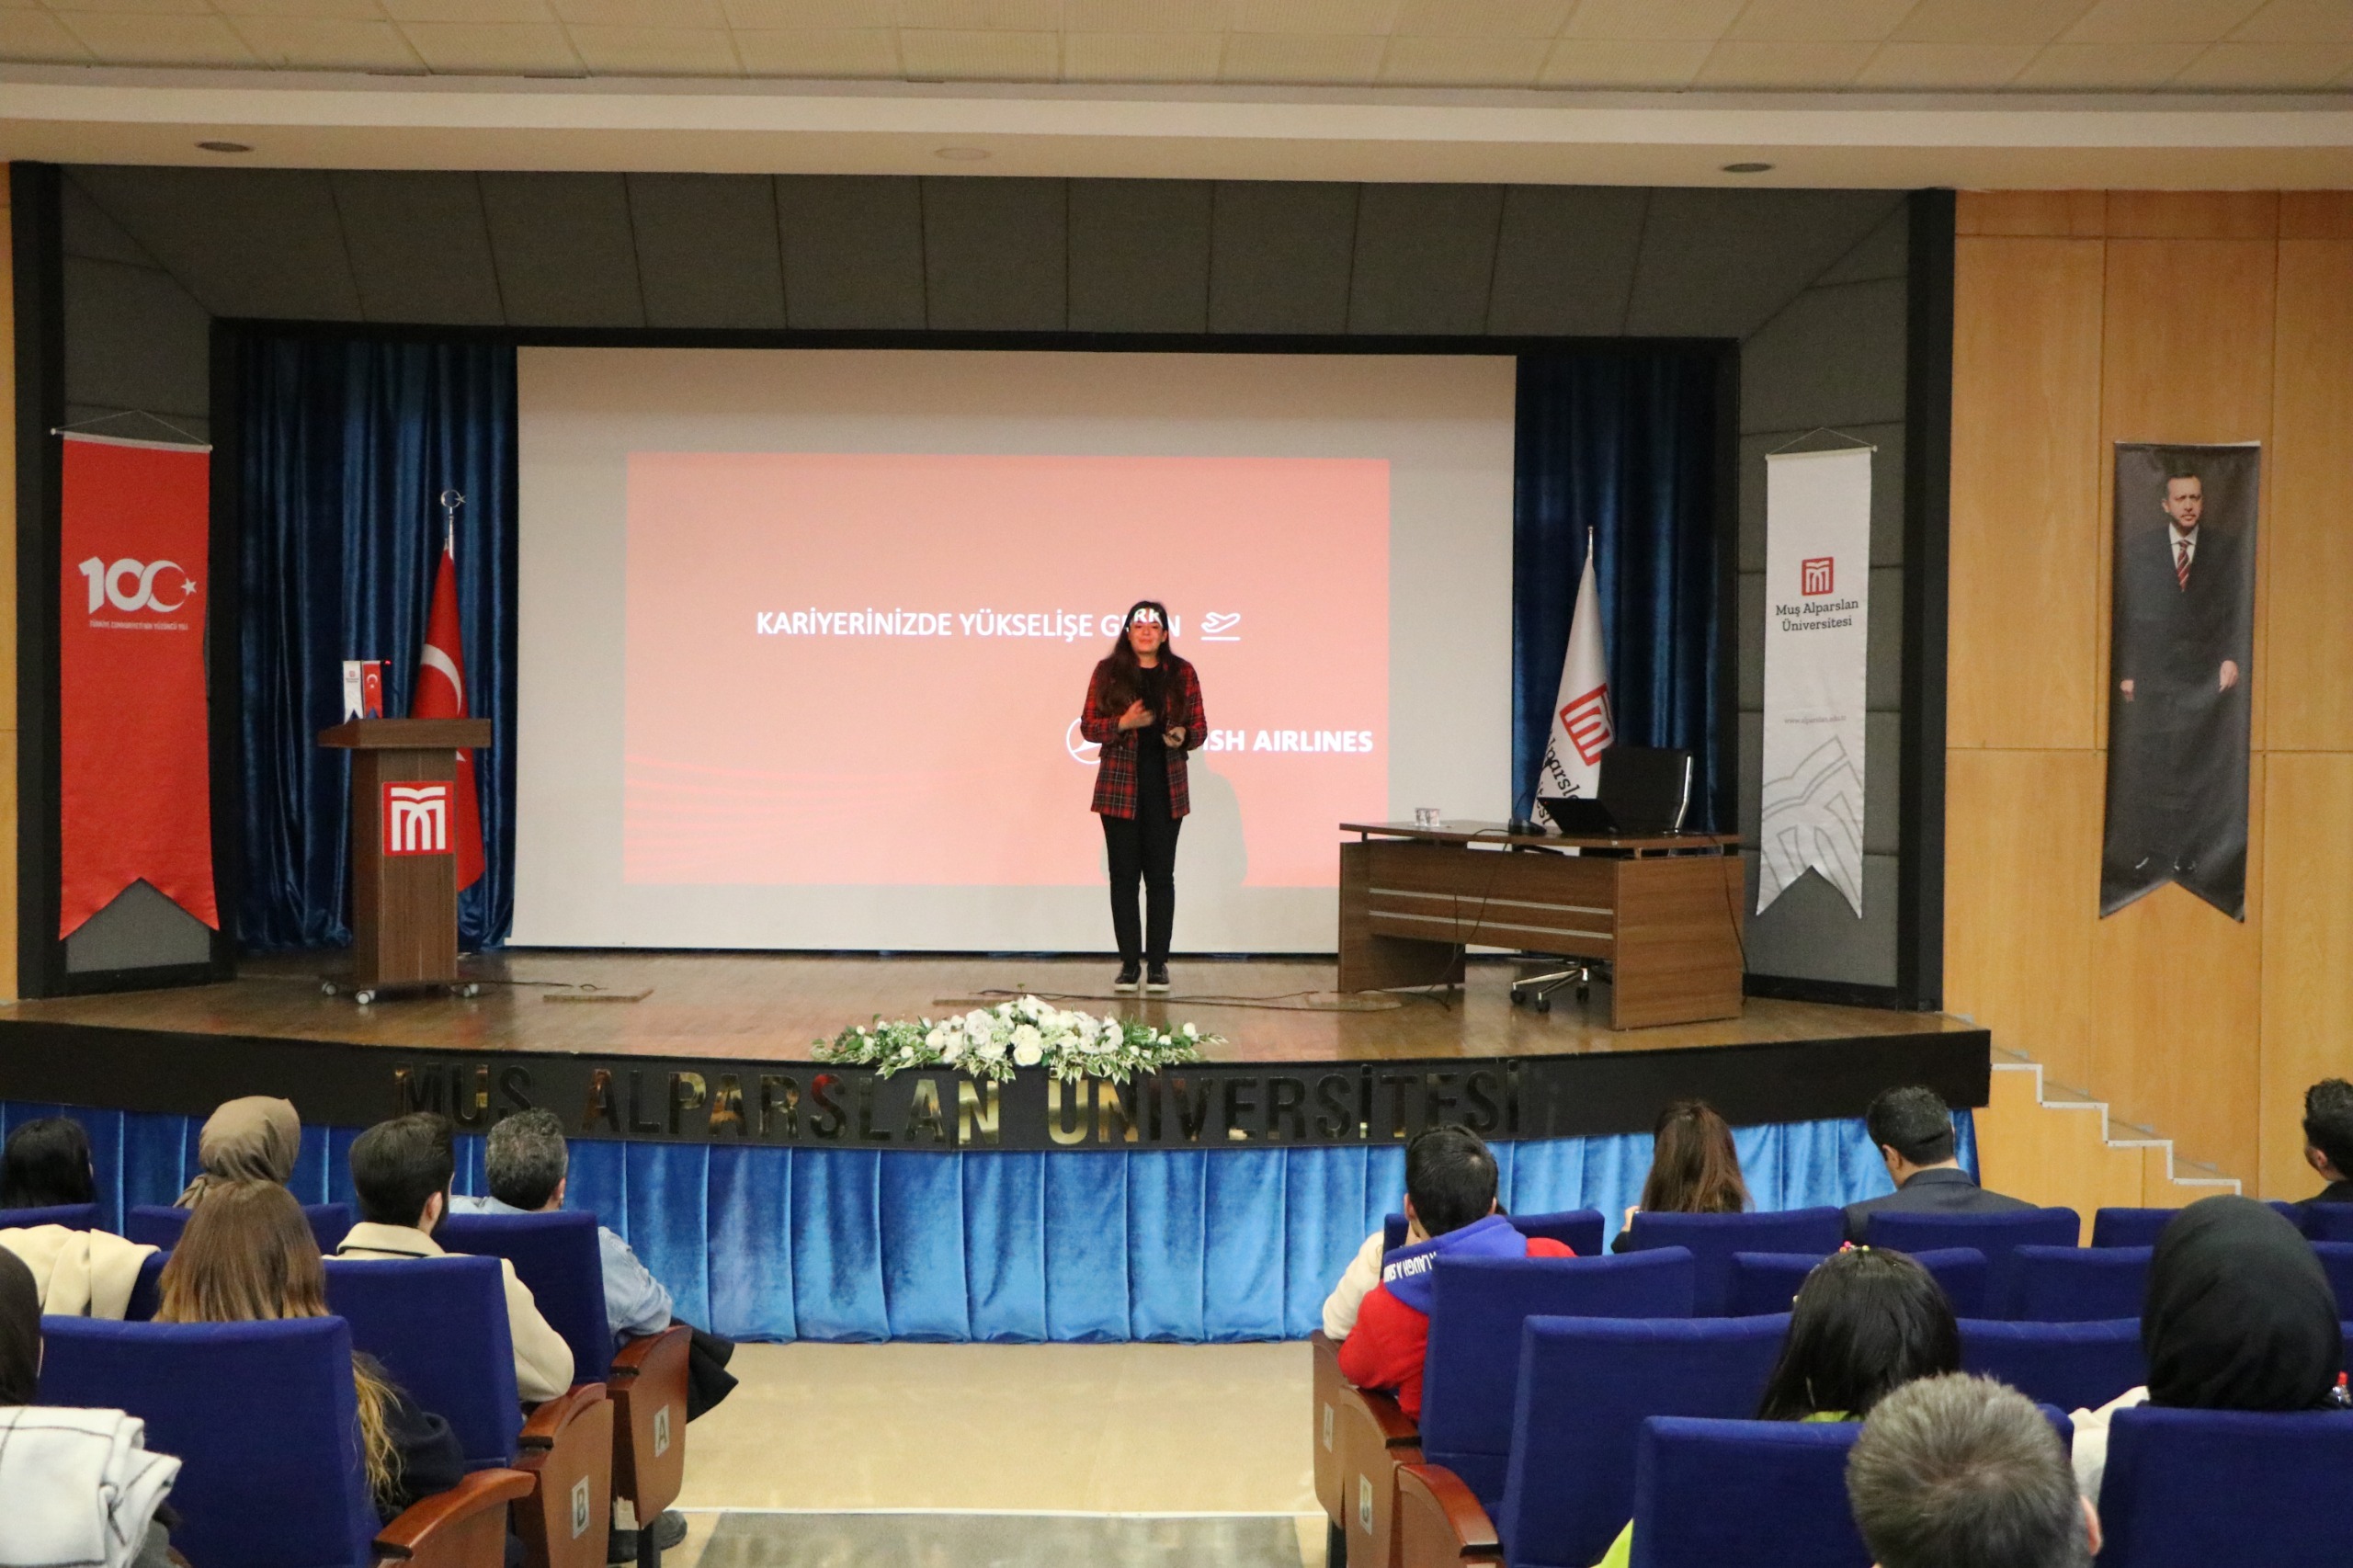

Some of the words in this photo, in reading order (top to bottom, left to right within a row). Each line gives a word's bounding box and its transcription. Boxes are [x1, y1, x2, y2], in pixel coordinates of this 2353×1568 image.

[756, 607, 953, 637] KARİYERİNİZDE
[959, 608, 1094, 642] YÜKSELİŞE
[1775, 604, 1801, 617] Muş
[1803, 599, 1859, 616] Alparslan
[1782, 615, 1853, 631] Üniversitesi
[1253, 730, 1374, 752] AIRLINES
[579, 1068, 1000, 1144] ALPARSLAN
[657, 1415, 667, 1450] A
[576, 1487, 586, 1528] B
